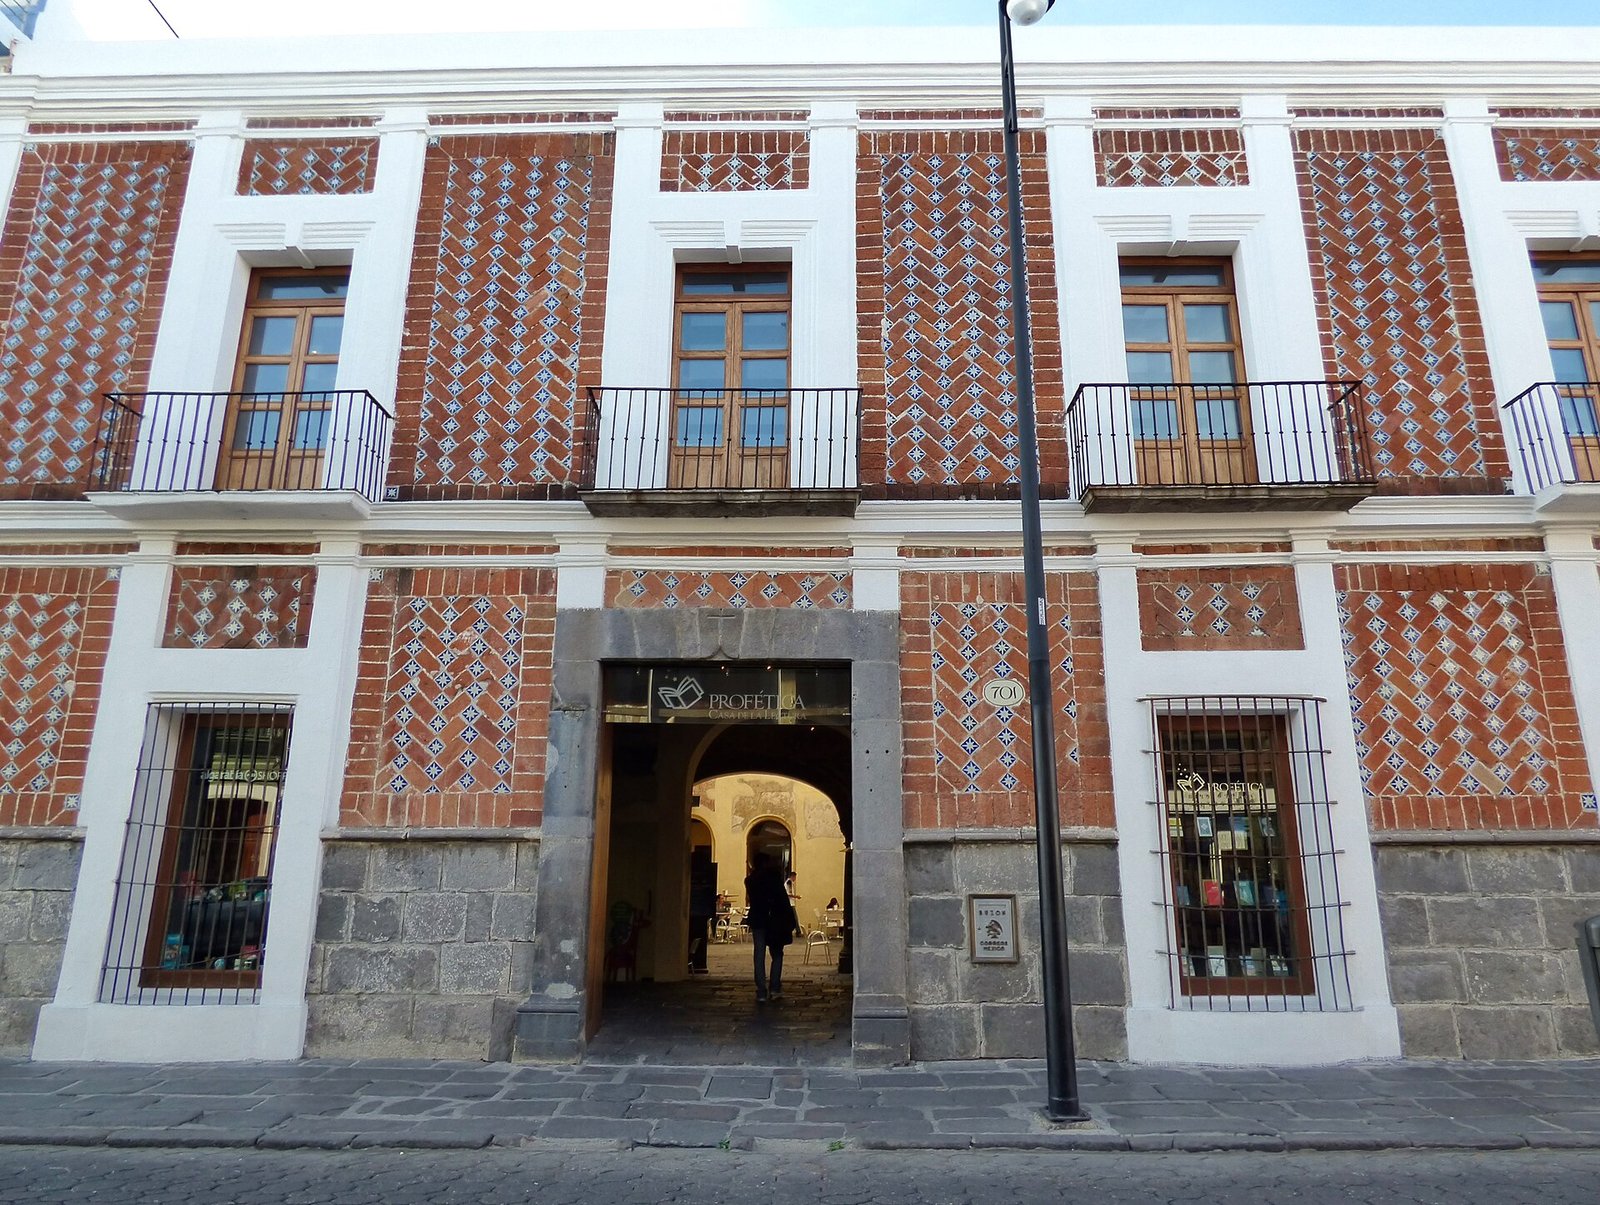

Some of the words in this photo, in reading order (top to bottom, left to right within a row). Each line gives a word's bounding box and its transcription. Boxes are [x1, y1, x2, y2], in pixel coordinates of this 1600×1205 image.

[709, 689, 806, 710] PROFÉTICA
[991, 686, 1017, 700] 701
[708, 709, 734, 720] CASA
[738, 711, 747, 720] DE
[750, 711, 762, 720] LA
